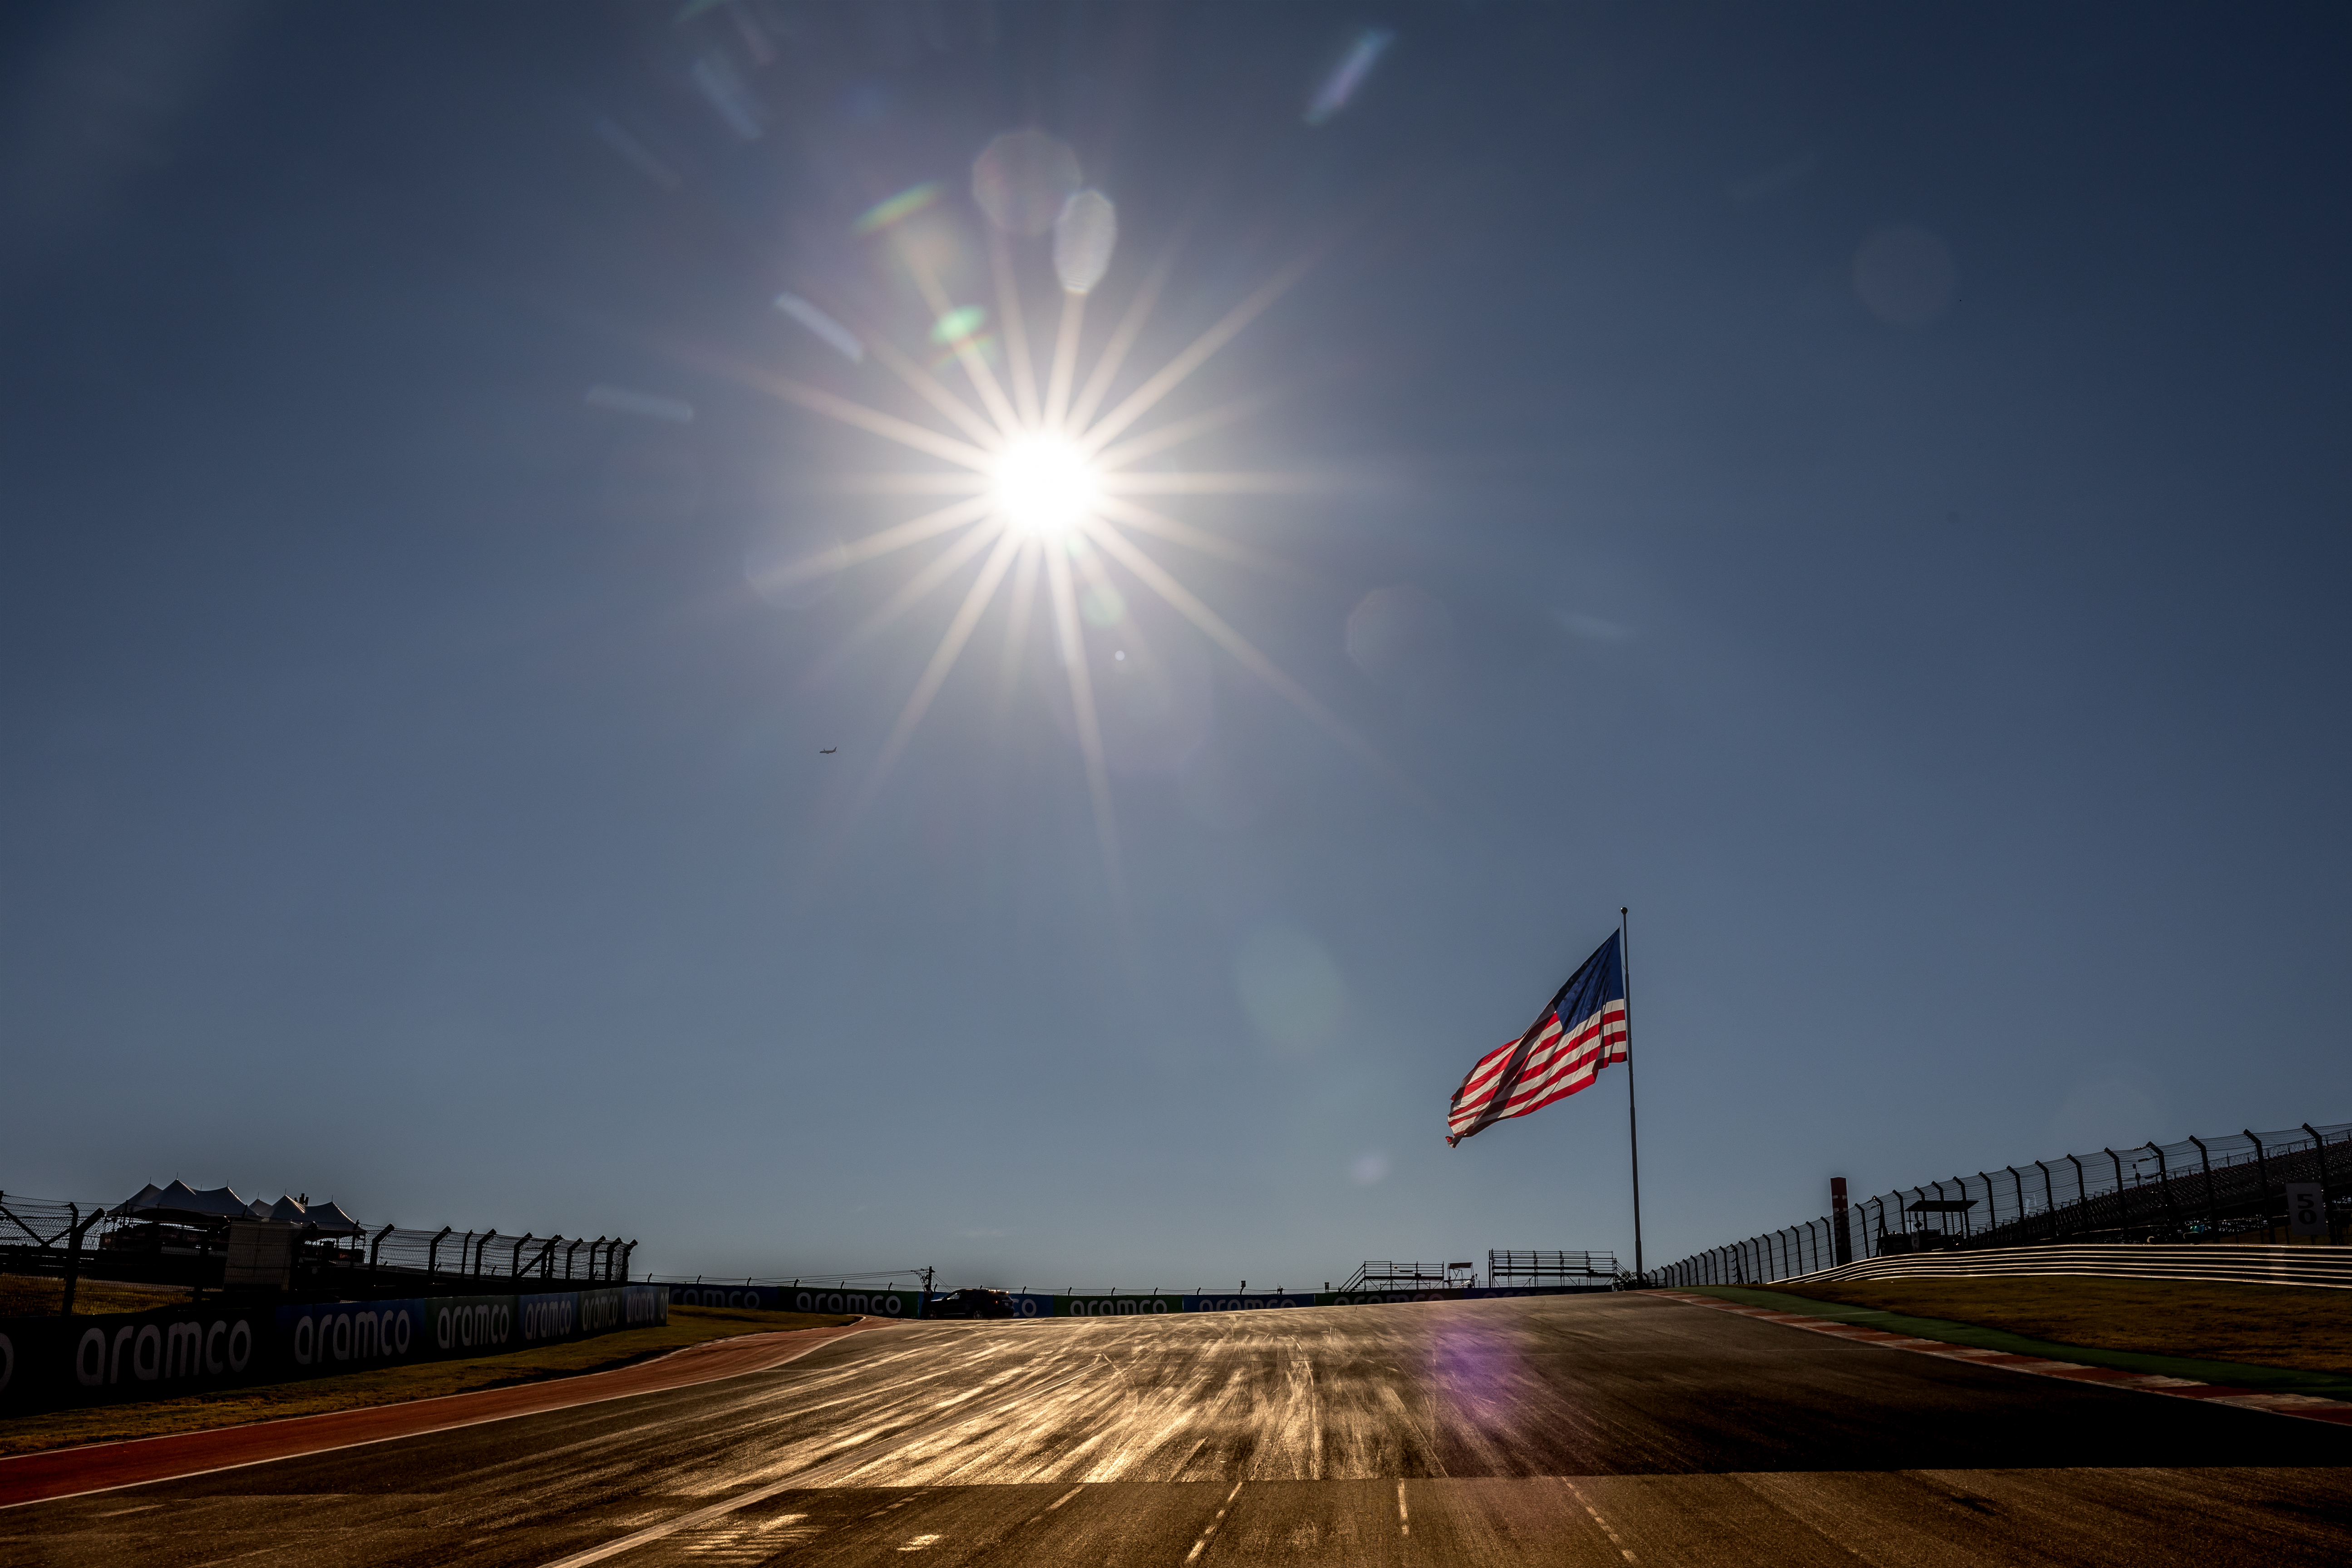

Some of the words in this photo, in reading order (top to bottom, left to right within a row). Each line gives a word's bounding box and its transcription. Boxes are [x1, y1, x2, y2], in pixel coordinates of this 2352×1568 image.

[525, 1300, 572, 1340] aramco
[583, 1295, 618, 1331] aramco
[627, 1292, 654, 1323] aramco
[796, 1292, 901, 1314] aramco
[1070, 1299, 1167, 1317] aramco
[294, 1309, 410, 1365] aramco
[437, 1304, 509, 1349] aramco
[76, 1319, 252, 1386] aramco
